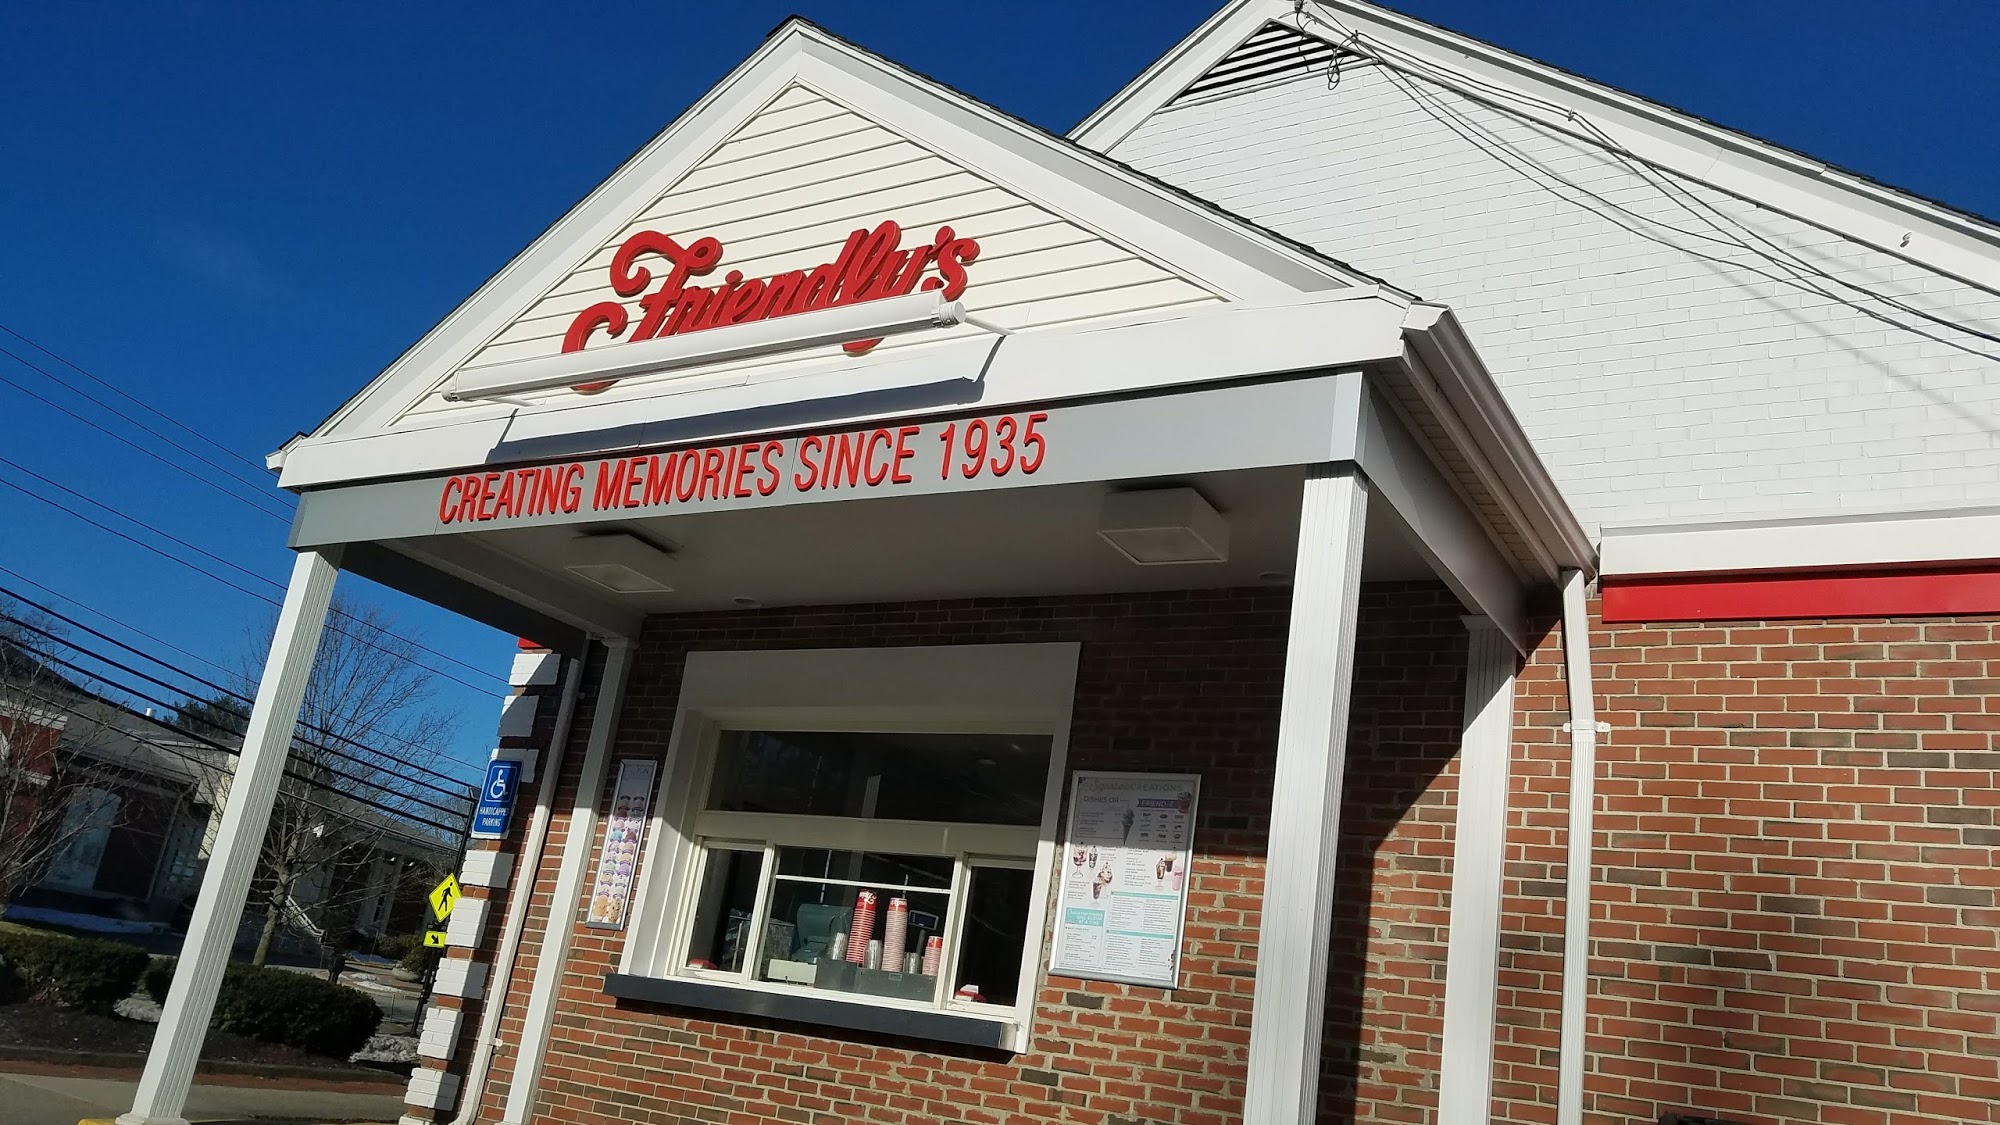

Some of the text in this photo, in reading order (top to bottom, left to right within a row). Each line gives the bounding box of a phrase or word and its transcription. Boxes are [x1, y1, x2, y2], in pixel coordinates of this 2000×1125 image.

[561, 219, 980, 391] Friendly's
[438, 412, 1050, 525] CREATING MEMORIES SINCE 1935
[481, 817, 502, 827] PARKING
